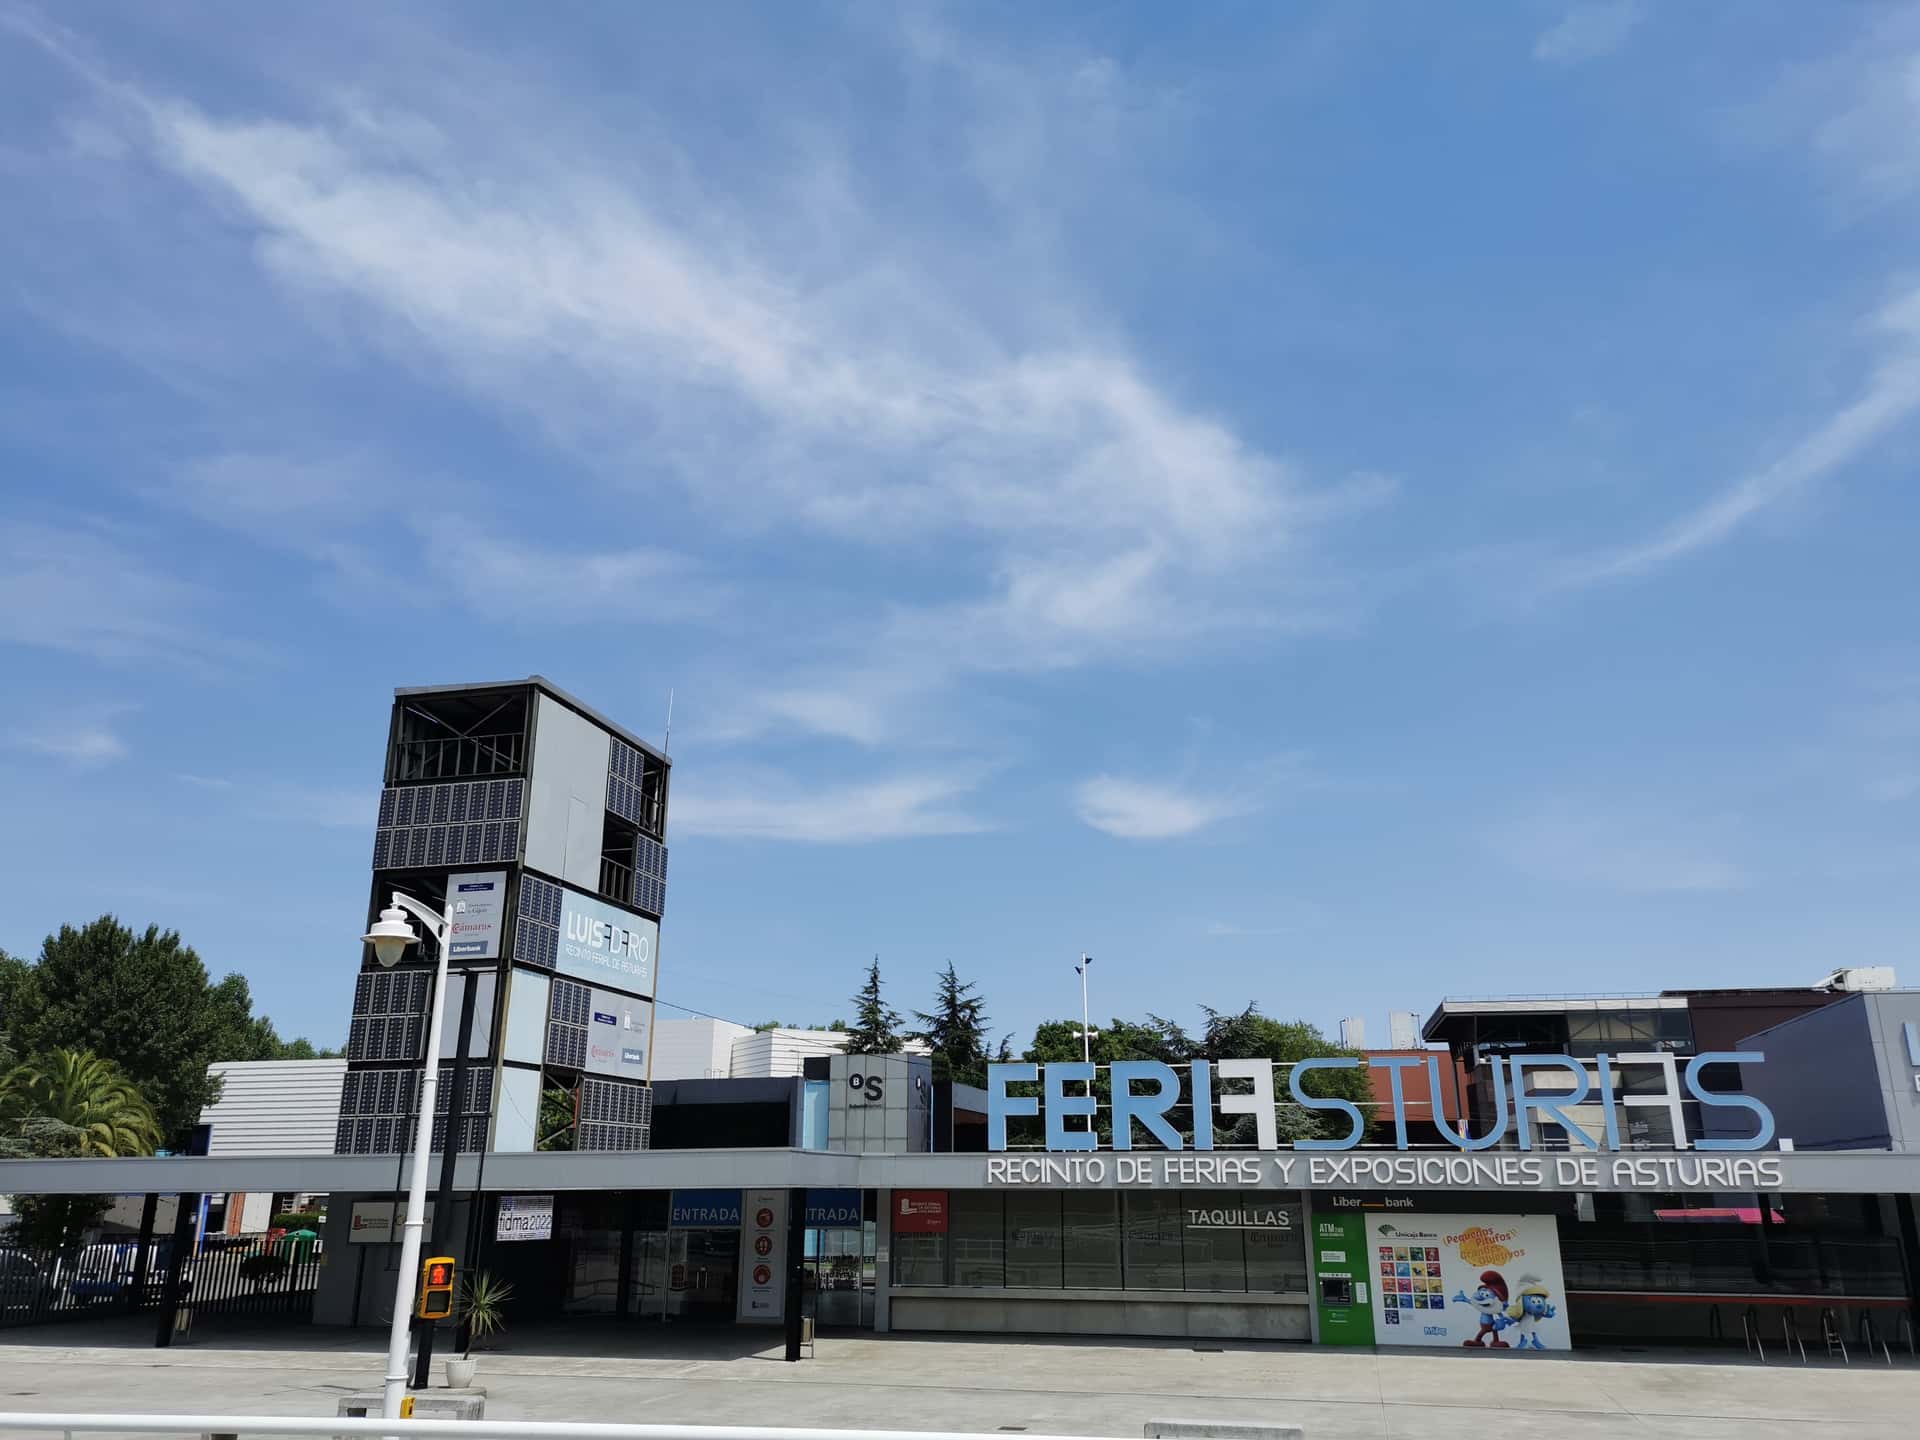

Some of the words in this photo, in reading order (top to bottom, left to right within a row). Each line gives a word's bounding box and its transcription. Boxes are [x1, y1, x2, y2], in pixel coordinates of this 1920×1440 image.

[987, 1157, 1105, 1184] RECINTO
[1117, 1158, 1153, 1184] DE
[1164, 1158, 1261, 1184] FERIAS
[1274, 1158, 1296, 1184] Y
[1309, 1157, 1543, 1185] EXPOSICIONES
[1556, 1158, 1599, 1186] DE
[1612, 1158, 1784, 1187] ASTURIAS
[672, 1207, 740, 1221] ENTRADA
[1187, 1209, 1290, 1226] TAQUILLAS
